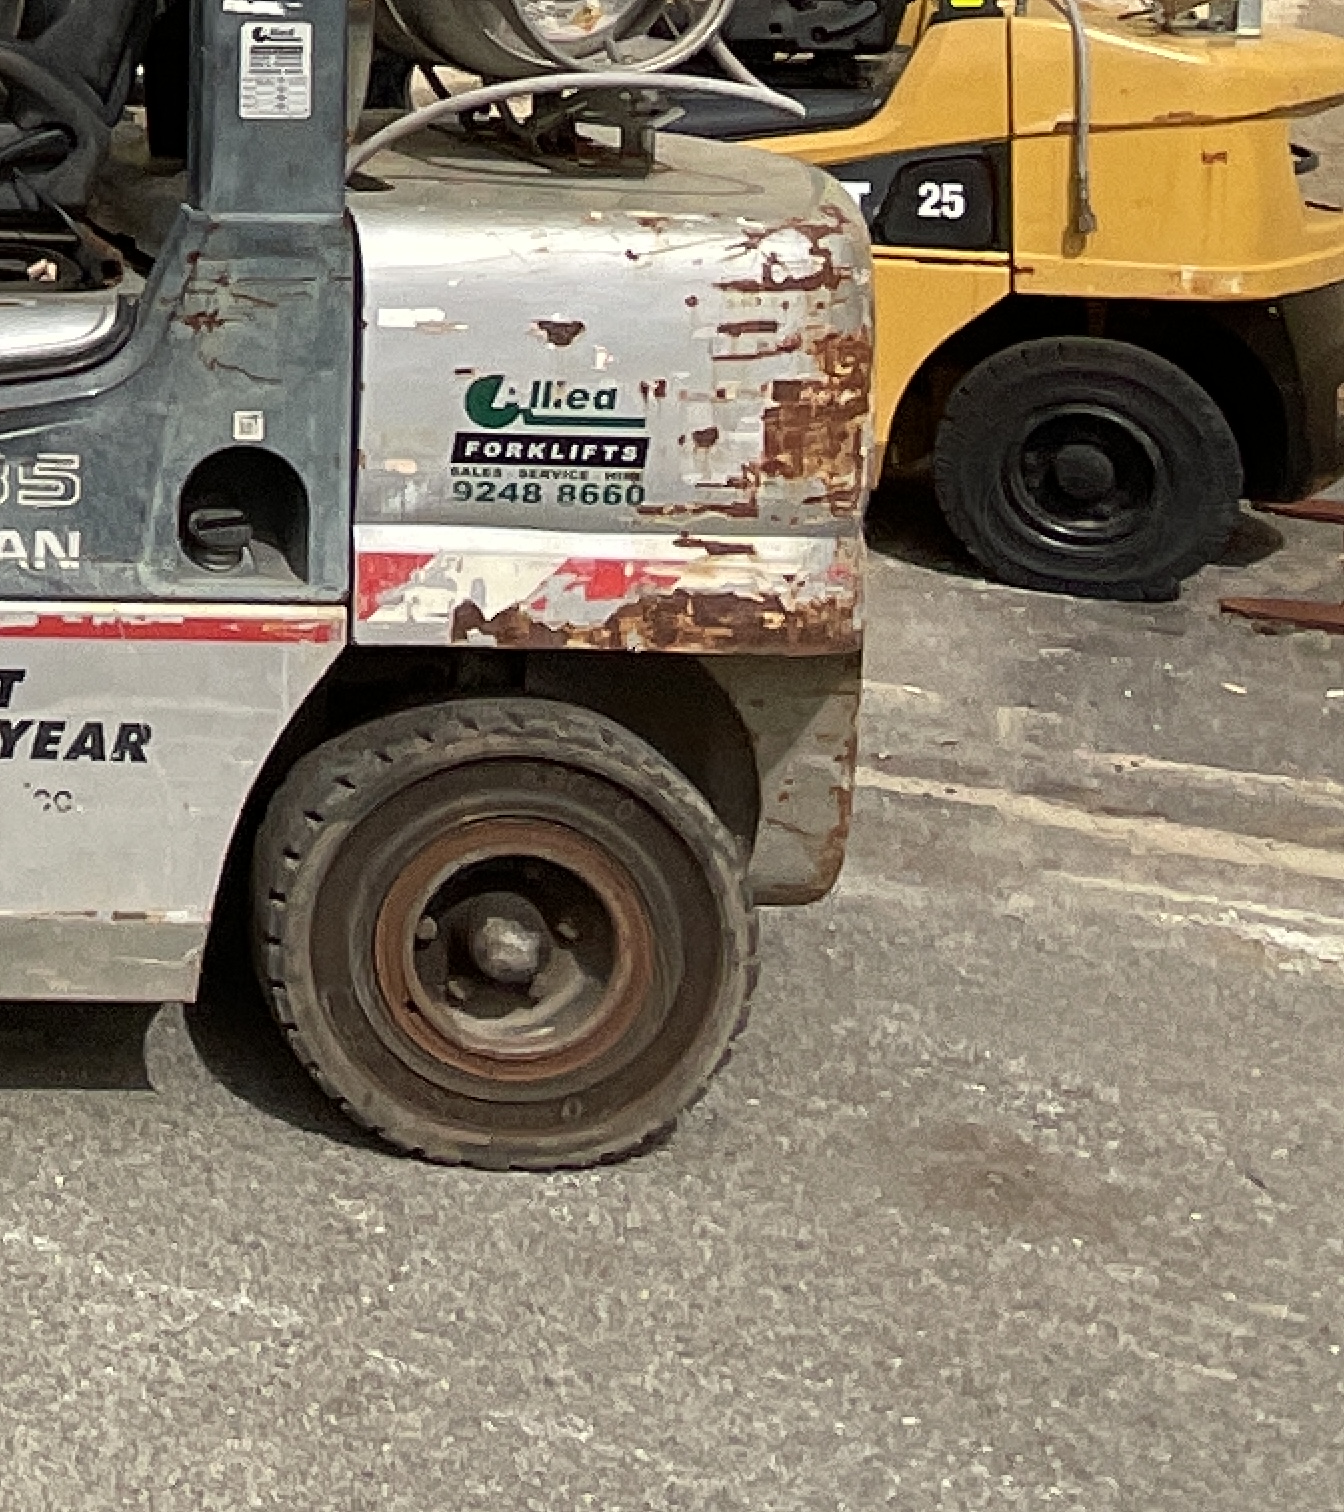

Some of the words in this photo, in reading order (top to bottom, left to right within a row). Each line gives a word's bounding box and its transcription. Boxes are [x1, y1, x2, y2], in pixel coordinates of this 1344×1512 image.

[917, 181, 967, 220] 25
[464, 441, 639, 462] FORKLIFTS
[452, 481, 542, 503] 9248
[556, 484, 646, 506] 8660
